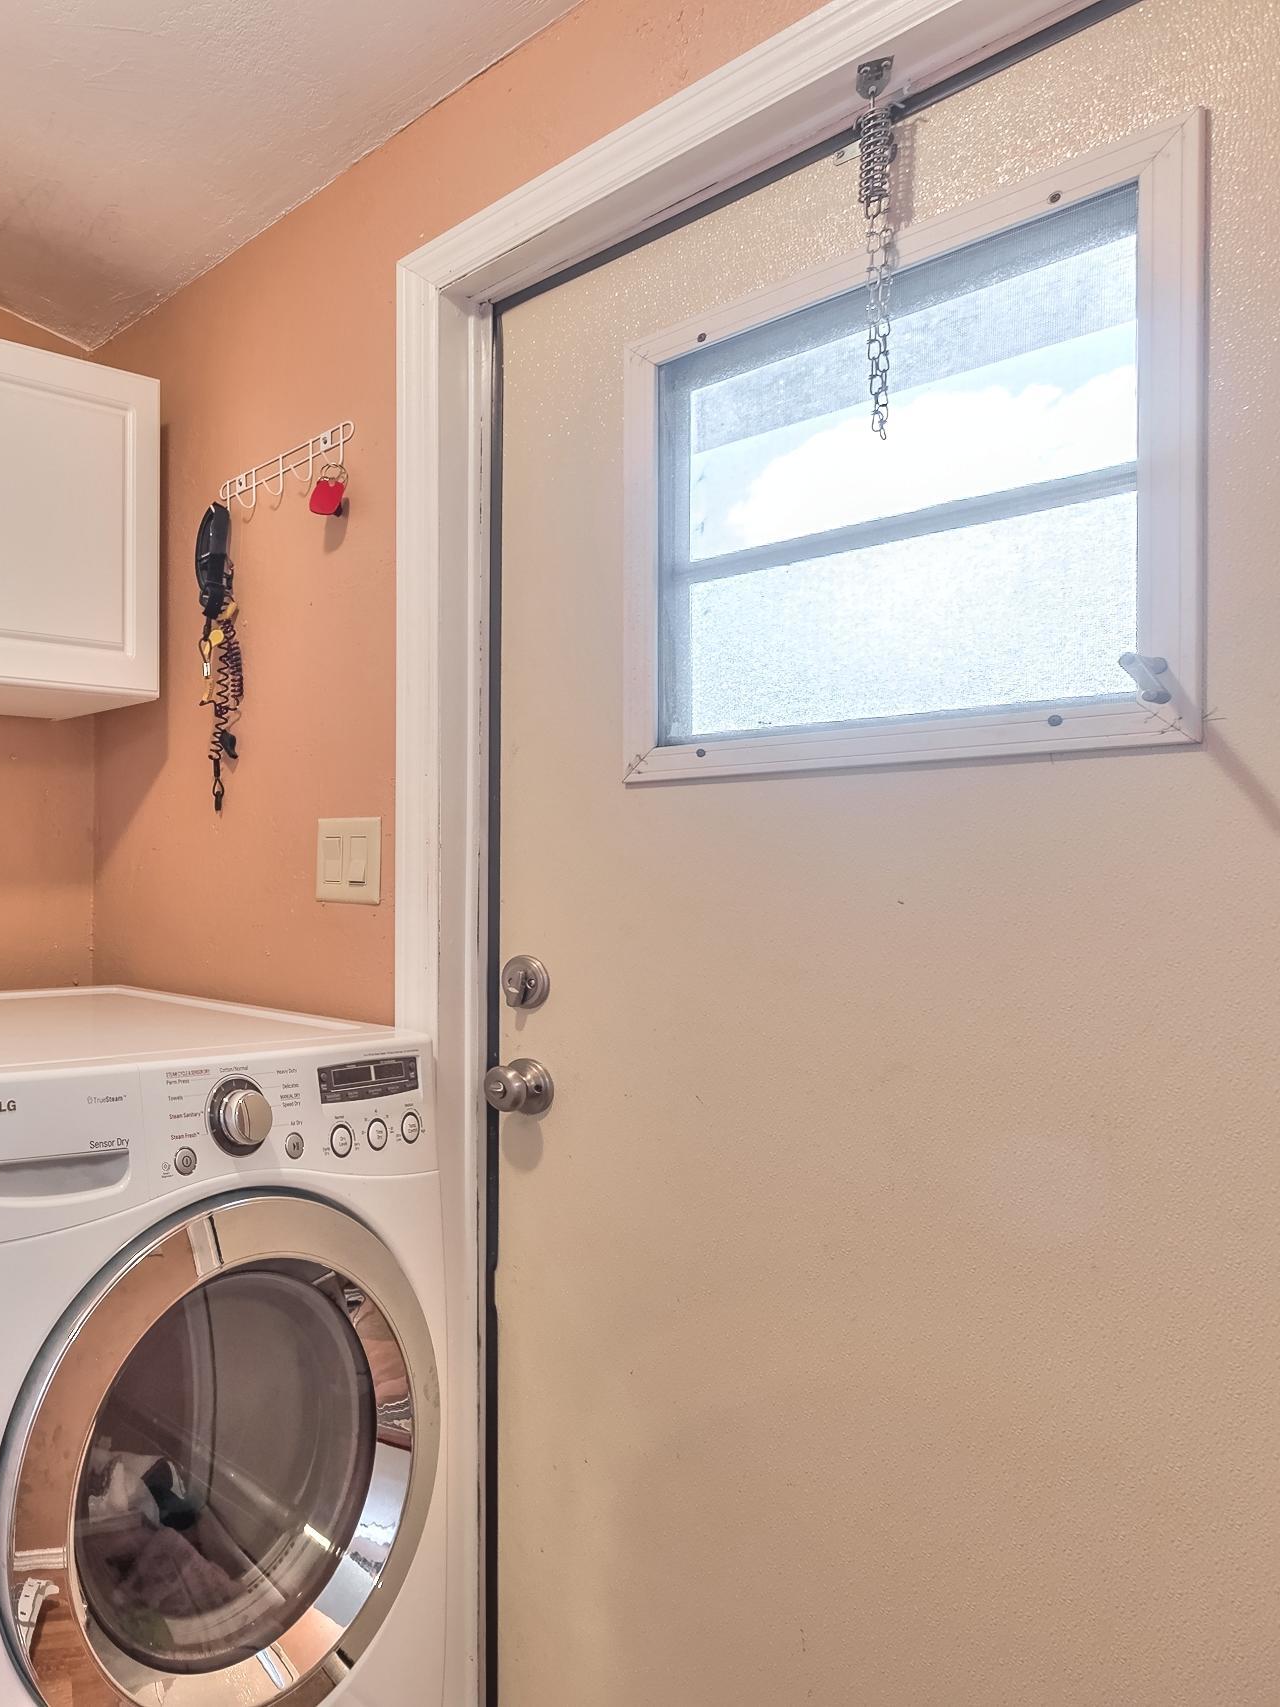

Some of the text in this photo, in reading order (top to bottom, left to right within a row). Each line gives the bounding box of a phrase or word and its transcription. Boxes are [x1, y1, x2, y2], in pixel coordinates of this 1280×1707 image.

[0, 1100, 17, 1112] LG
[90, 1138, 130, 1149] Sensor Dry
